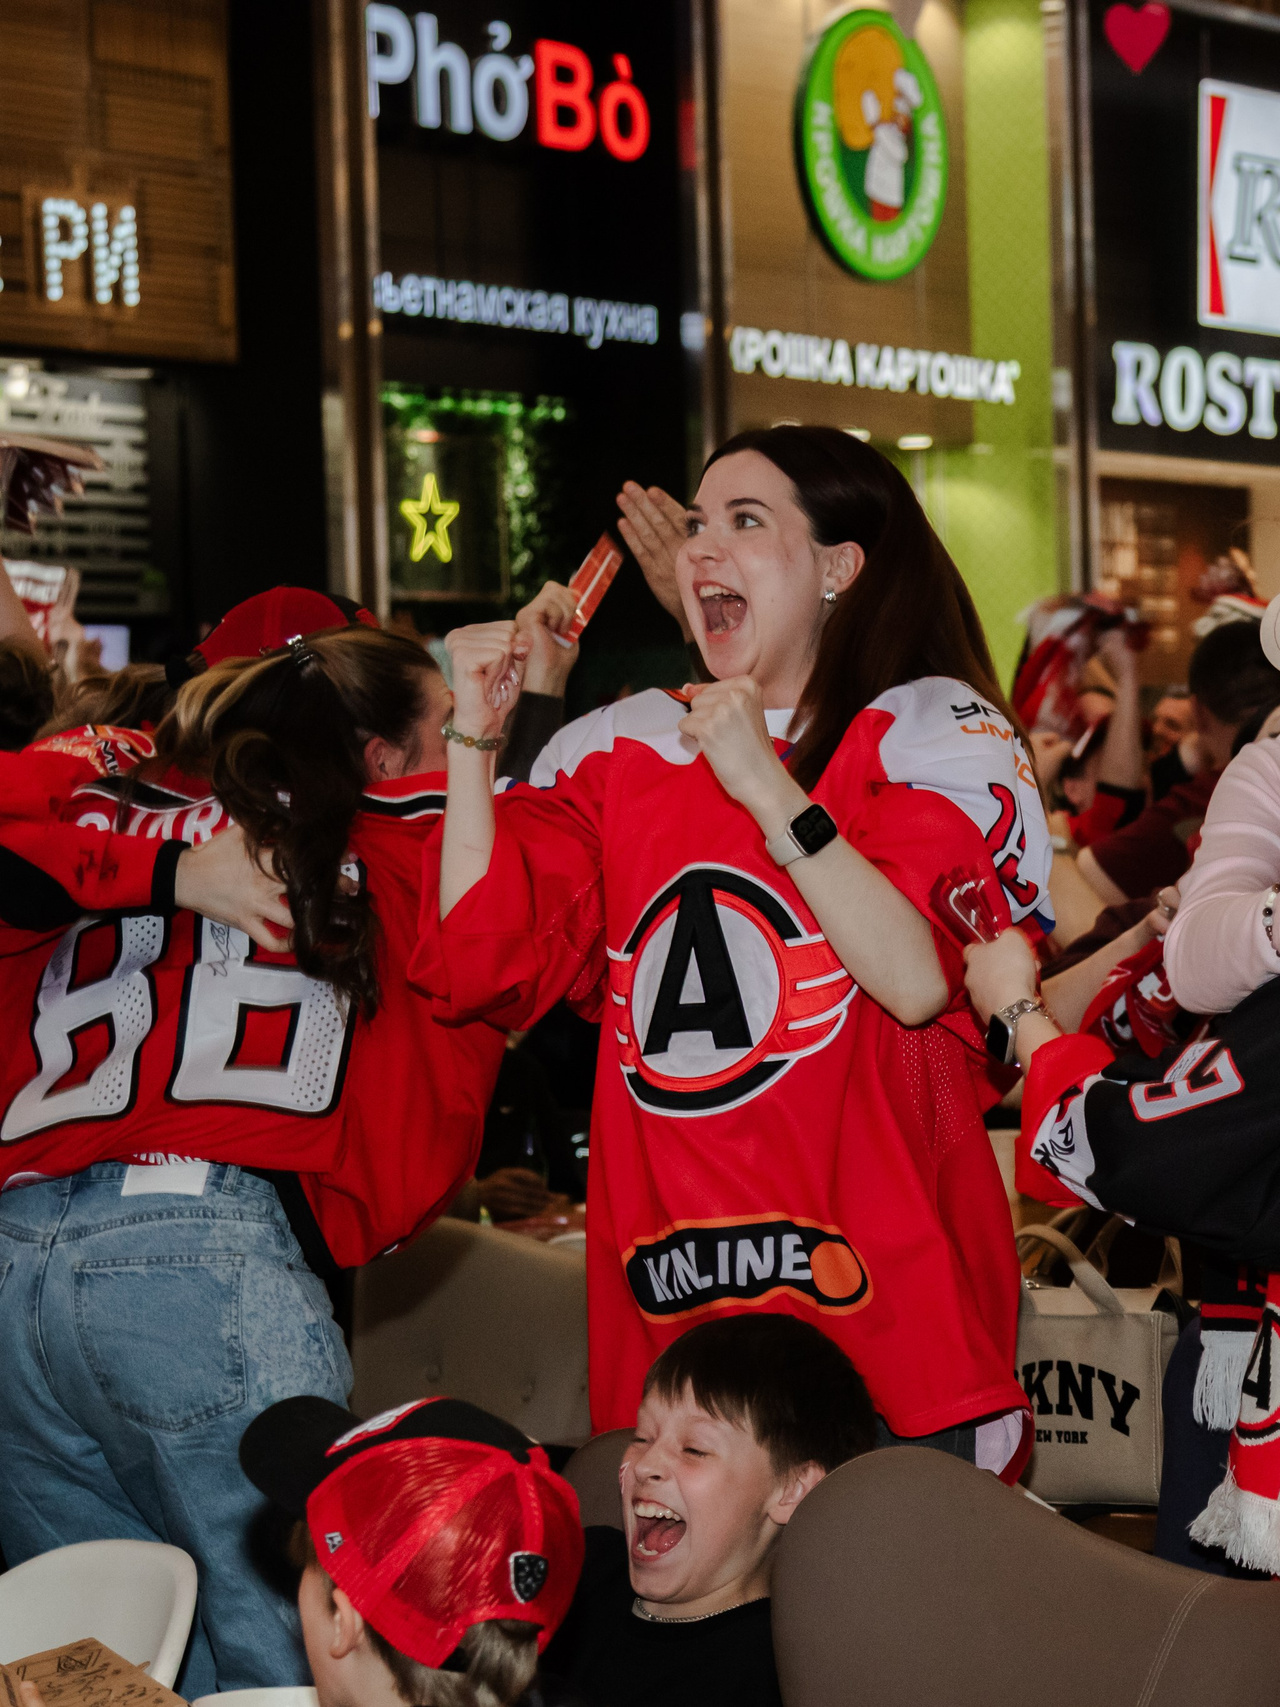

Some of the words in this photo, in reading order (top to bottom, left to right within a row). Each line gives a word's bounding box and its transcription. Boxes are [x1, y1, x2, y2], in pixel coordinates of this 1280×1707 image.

[573, 297, 658, 349] кухня
[855, 342, 1017, 405] КАРТОШКА
[642, 872, 754, 1056] А
[1014, 1360, 1140, 1437] KNY
[1035, 1429, 1052, 1443] EW
[1055, 1430, 1088, 1444] YORK
